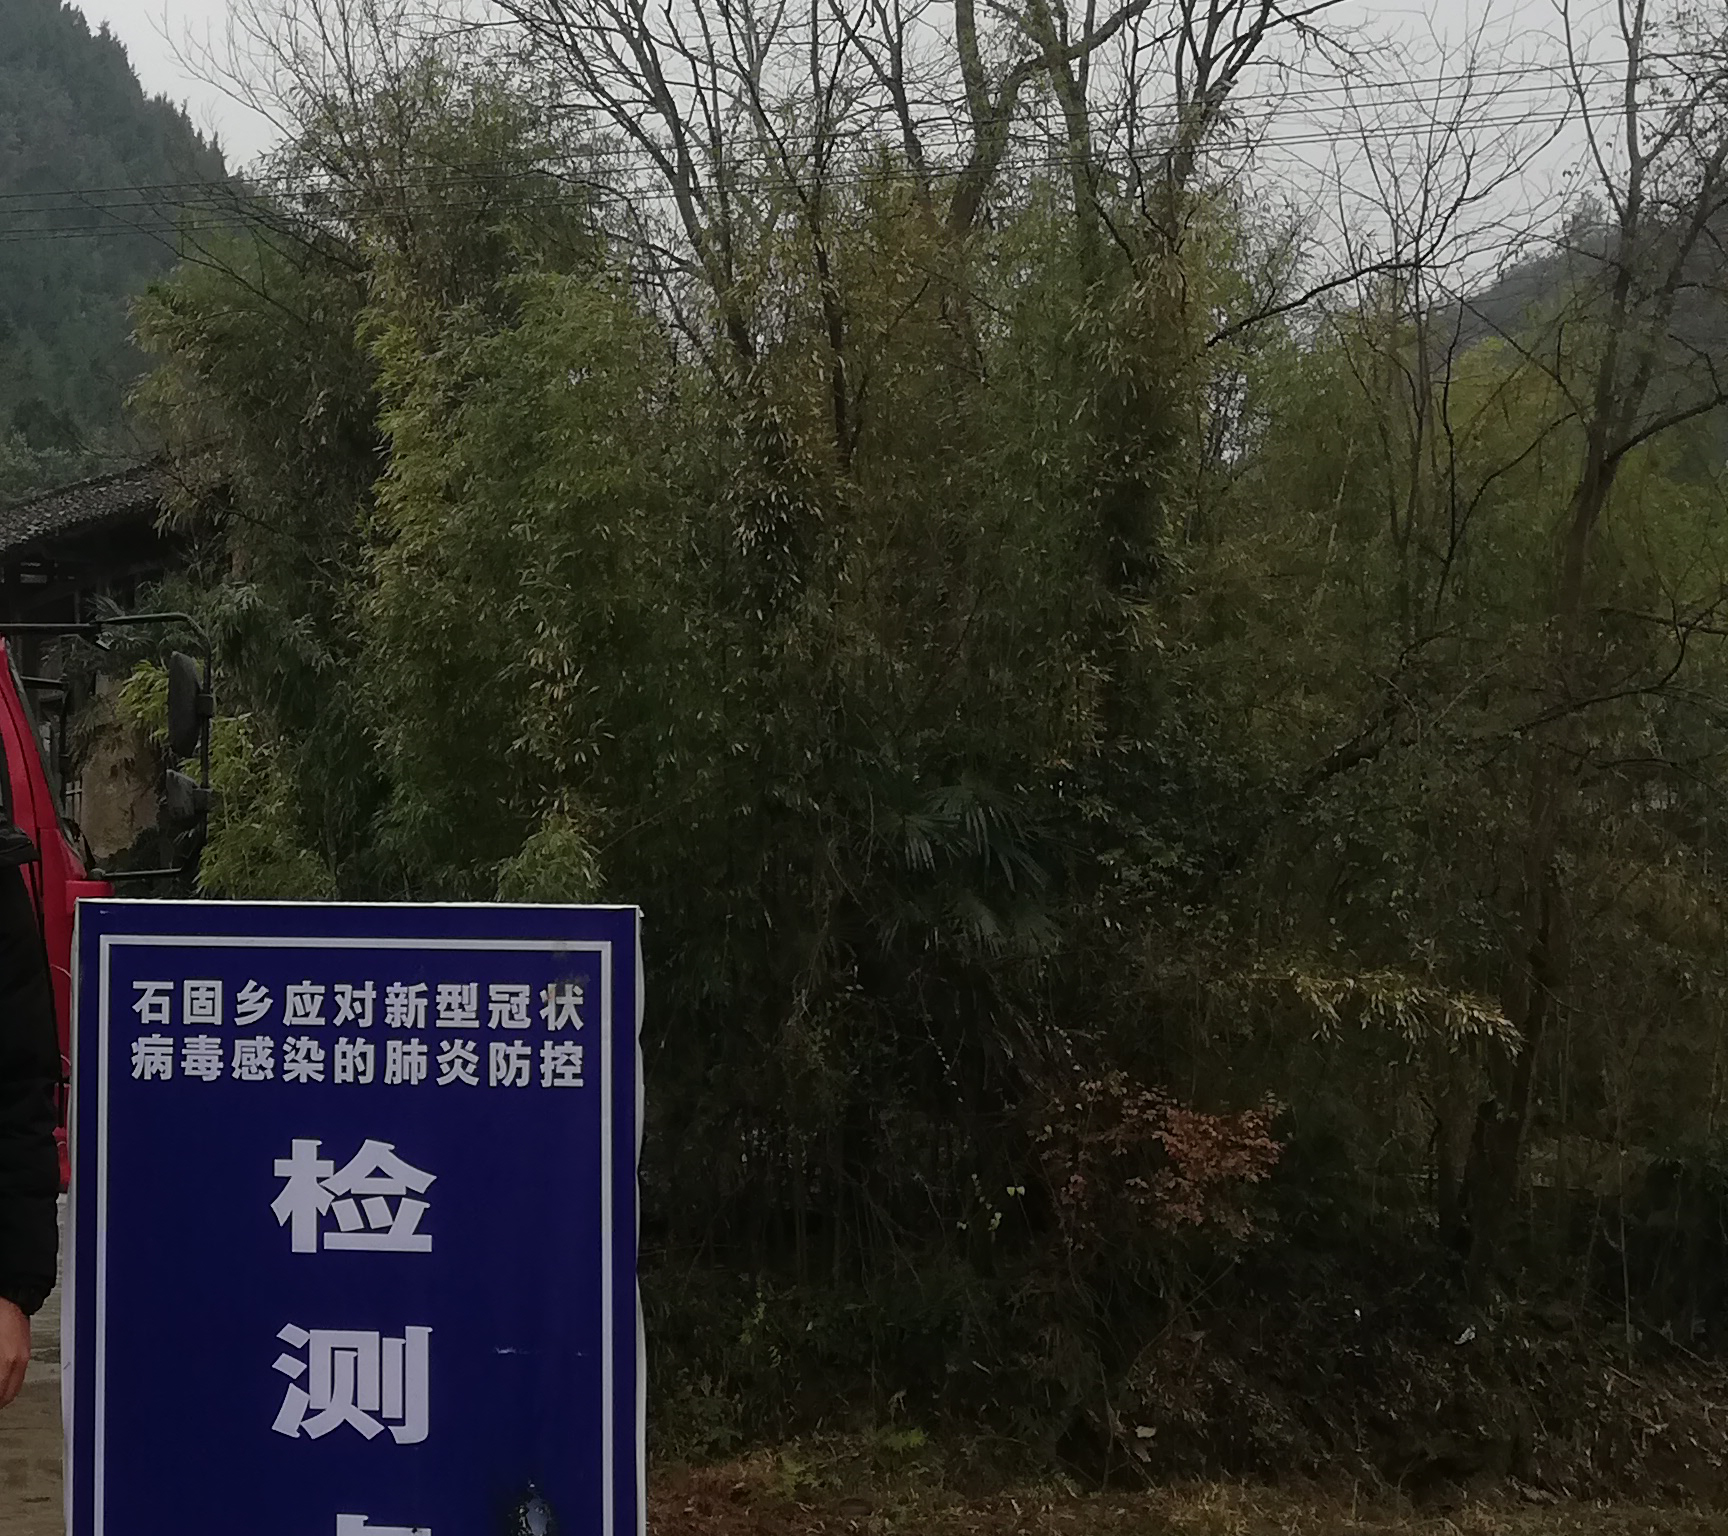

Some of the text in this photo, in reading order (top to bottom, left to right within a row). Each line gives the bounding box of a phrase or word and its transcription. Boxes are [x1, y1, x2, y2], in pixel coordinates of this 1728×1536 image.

[131, 979, 586, 1032] 石固乡应对新型冠状
[130, 1034, 586, 1088] 病毒感染的肺炎防控
